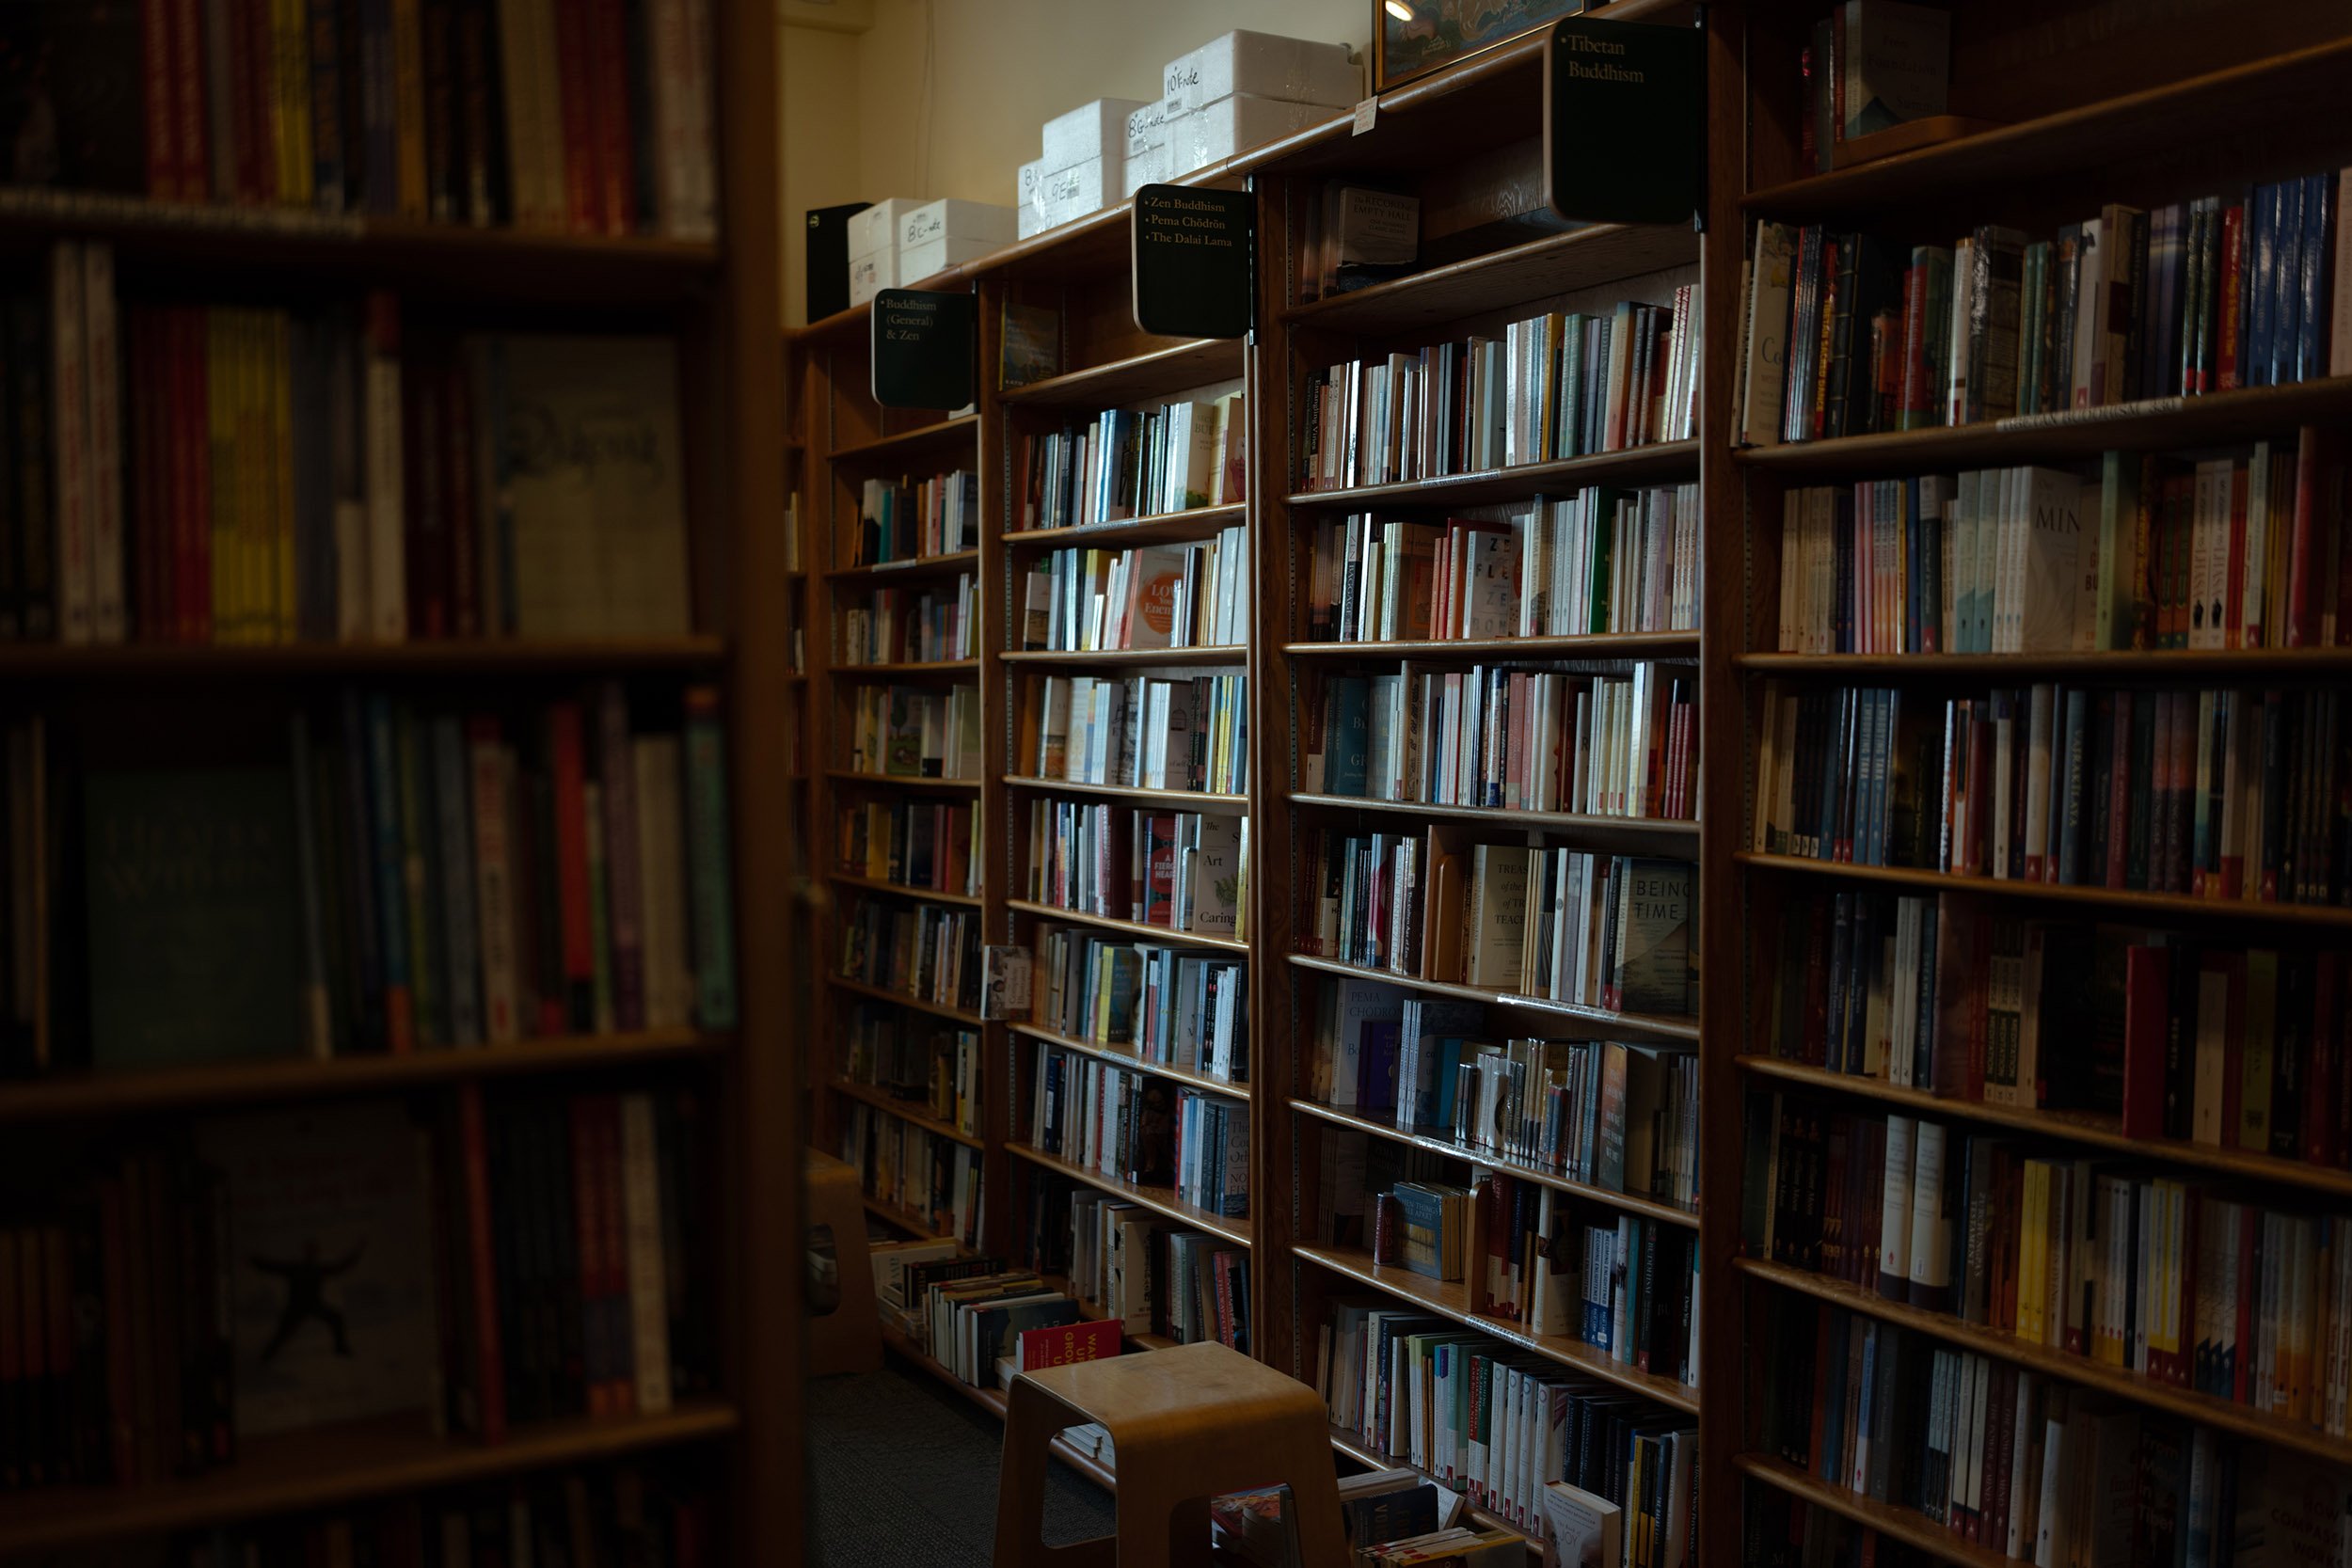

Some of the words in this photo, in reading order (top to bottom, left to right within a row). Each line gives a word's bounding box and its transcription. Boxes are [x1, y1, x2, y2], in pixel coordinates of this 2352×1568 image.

[1567, 34, 1626, 55] Tibetan
[1567, 60, 1645, 83] Buddhism
[1151, 197, 1171, 209] Zen
[1174, 198, 1226, 212] Buddhism
[1354, 205, 1387, 217] EMPTY
[1388, 209, 1410, 221] HALL
[1151, 214, 1180, 227] Pema
[1152, 231, 1172, 243] The
[1175, 233, 1201, 245] Dalai
[1204, 235, 1232, 247] Lama
[886, 298, 936, 311] Buddhism
[887, 314, 934, 328] (General)
[1820, 299, 1833, 338] TIBETAN
[886, 330, 897, 340] &
[899, 331, 920, 341] Zen
[1599, 321, 1610, 368] HIDDEN
[1818, 341, 1829, 376] SACRED
[1598, 372, 1607, 394] ZEN
[1311, 379, 1321, 424] Entangling
[1815, 379, 1826, 412] DANCE
[1311, 426, 1320, 450] Vines
[1345, 564, 1354, 615] BAGGAGE
[1859, 758, 1871, 780] TARA
[1873, 758, 1885, 780] TARA
[1203, 855, 1222, 867] Art
[1200, 911, 1236, 926] Caring
[1635, 901, 1679, 920] TIME
[1351, 991, 1380, 1002] PEMA
[1918, 1019, 1929, 1052] LIGHT
[1986, 1015, 1995, 1074] MEDITATION
[1997, 1018, 2008, 1077] MEDITATION
[2008, 1018, 2019, 1078] MEDITATION
[1593, 1232, 1601, 1261] BECOMING
[1602, 1234, 1611, 1264] BECOMING
[1644, 1242, 1654, 1294] BUDDHISM
[1592, 1263, 1600, 1302] ENLIGHTENED
[1560, 1530, 1578, 1545] JOY
